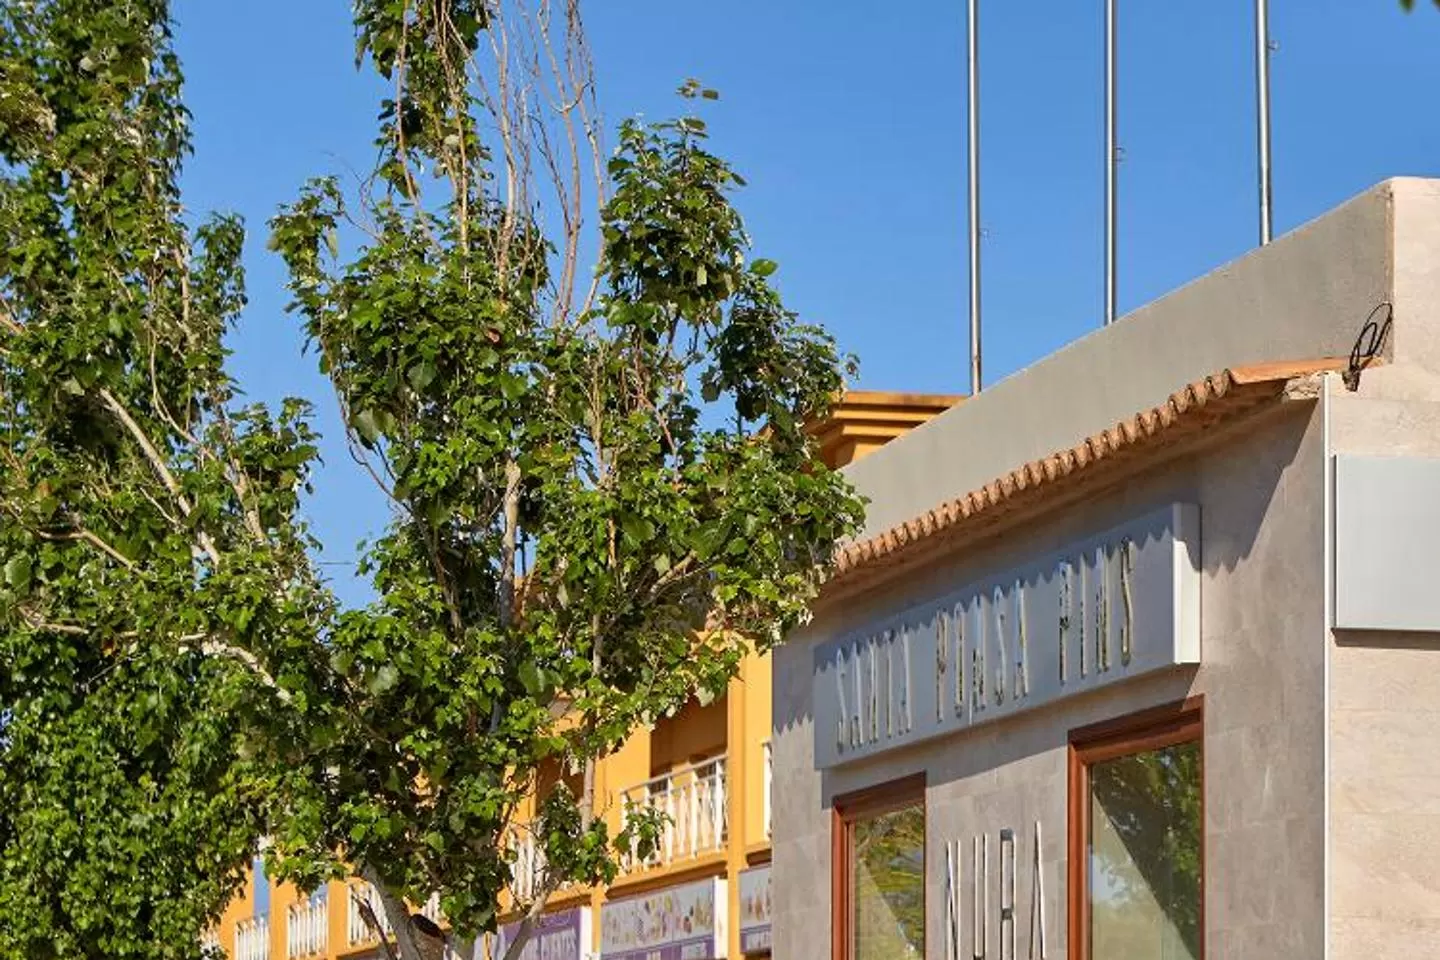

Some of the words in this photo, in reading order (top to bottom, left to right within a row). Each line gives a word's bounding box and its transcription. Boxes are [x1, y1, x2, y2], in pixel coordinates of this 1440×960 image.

[834, 625, 914, 754] SANTA
[935, 578, 1030, 722] PONSA
[1057, 537, 1136, 682] PINS
